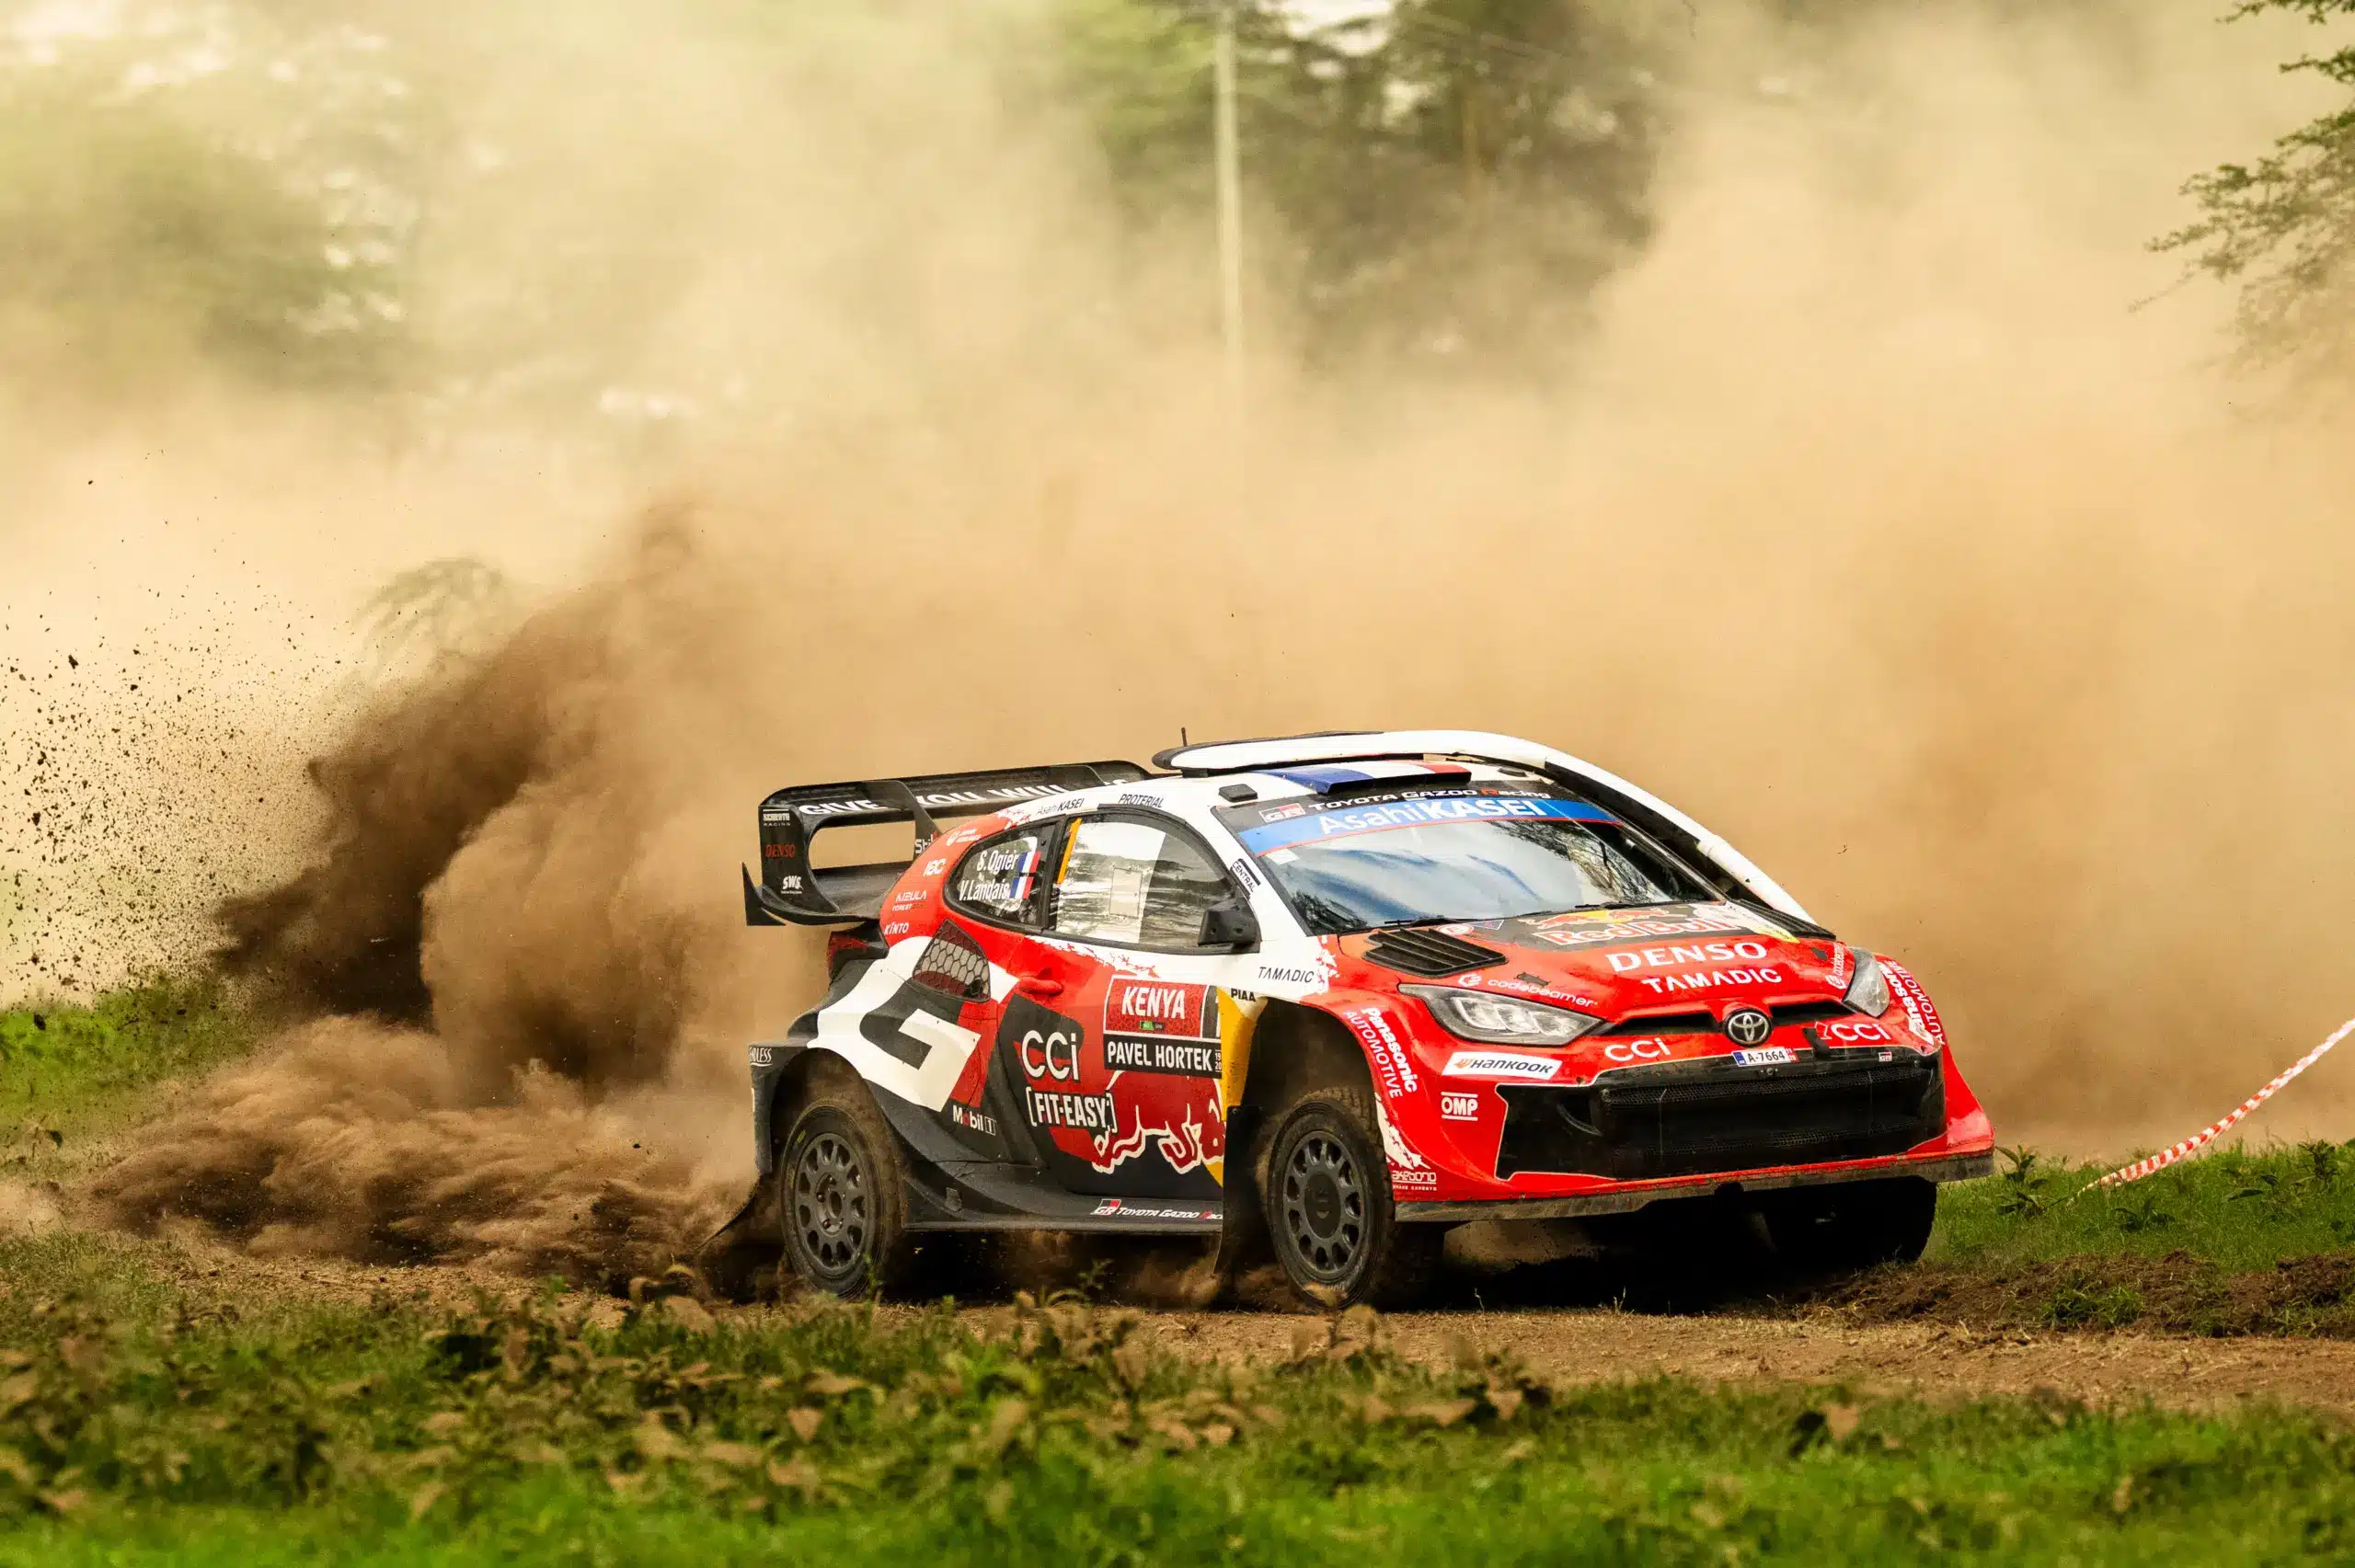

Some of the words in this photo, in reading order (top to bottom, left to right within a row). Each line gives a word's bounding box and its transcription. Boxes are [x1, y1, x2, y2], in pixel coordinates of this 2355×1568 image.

[798, 799, 889, 815] GIVE
[1119, 794, 1164, 808] PROTERIAL
[1308, 794, 1398, 811] TOYOTA
[1401, 789, 1478, 799] GAZOO
[764, 844, 796, 858] DENSO
[782, 876, 803, 890] SWS
[1232, 861, 1256, 893] CENTRAL
[1605, 941, 1768, 973] DENSO
[1258, 967, 1315, 983] TAMADIC
[1640, 968, 1783, 994] TAMADIC
[1121, 986, 1186, 1020] KENYA
[1230, 988, 1257, 1002] PIAA
[1488, 979, 1595, 1008] codebeamer
[1108, 1041, 1153, 1067] PAVEL
[1155, 1045, 1213, 1071] HORTEK
[1343, 1011, 1404, 1099] AUTOMOTIVE
[1361, 1007, 1419, 1093] Panasonic
[1747, 1050, 1786, 1063] A-7664
[1441, 1096, 1478, 1116] OMP
[953, 1104, 984, 1131] Mobil
[1117, 1207, 1159, 1217] TOYOTA
[1159, 1208, 1200, 1219] GAZOO
